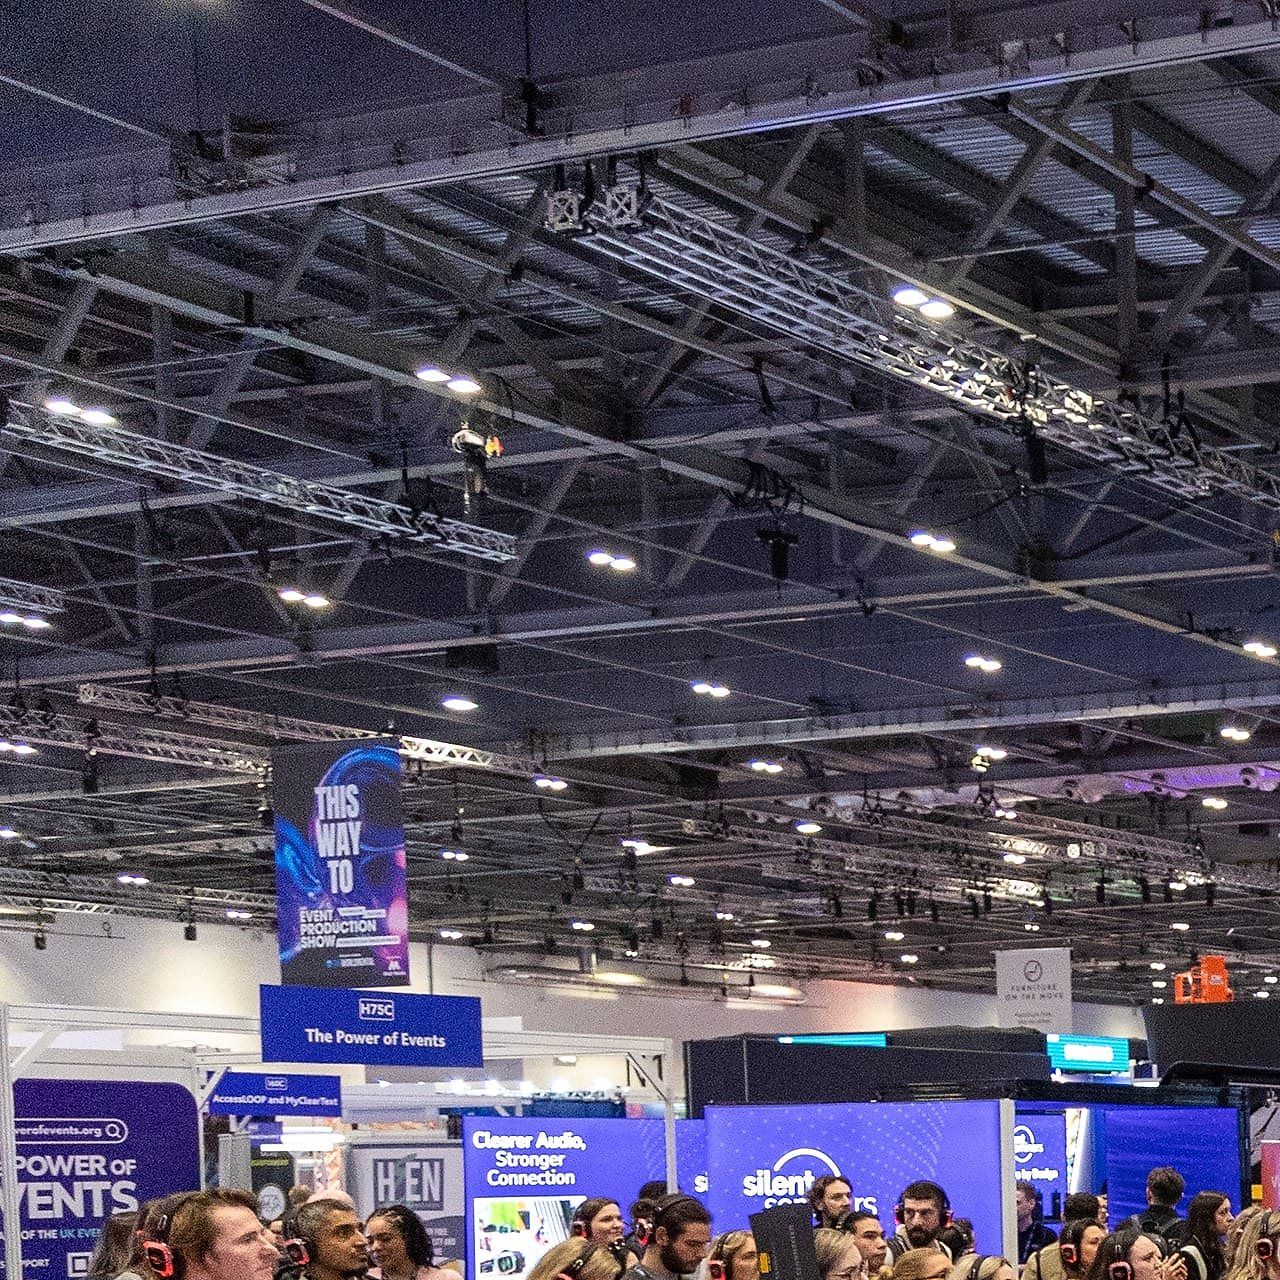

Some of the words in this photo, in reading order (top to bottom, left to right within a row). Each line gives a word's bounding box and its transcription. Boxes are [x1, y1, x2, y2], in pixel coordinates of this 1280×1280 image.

[314, 784, 360, 820] THIS
[314, 821, 362, 857] WAY
[327, 859, 354, 894] TO
[301, 908, 333, 922] EVENT
[301, 920, 376, 936] PRODUCTION
[301, 935, 336, 949] SHOW
[361, 1002, 393, 1018] H75C
[305, 1028, 333, 1043] The
[336, 1030, 380, 1046] Power
[383, 1031, 398, 1046] of
[402, 1033, 446, 1048] Events
[267, 1095, 284, 1106] and
[472, 1131, 533, 1149] Clearer
[535, 1131, 587, 1151] Audio,
[110, 1159, 137, 1176] OF
[495, 1151, 566, 1169] Stronger
[486, 1169, 576, 1187] Connection
[742, 1170, 816, 1197] silent
[38, 1229, 58, 1239] THE
[60, 1229, 75, 1239] UK
